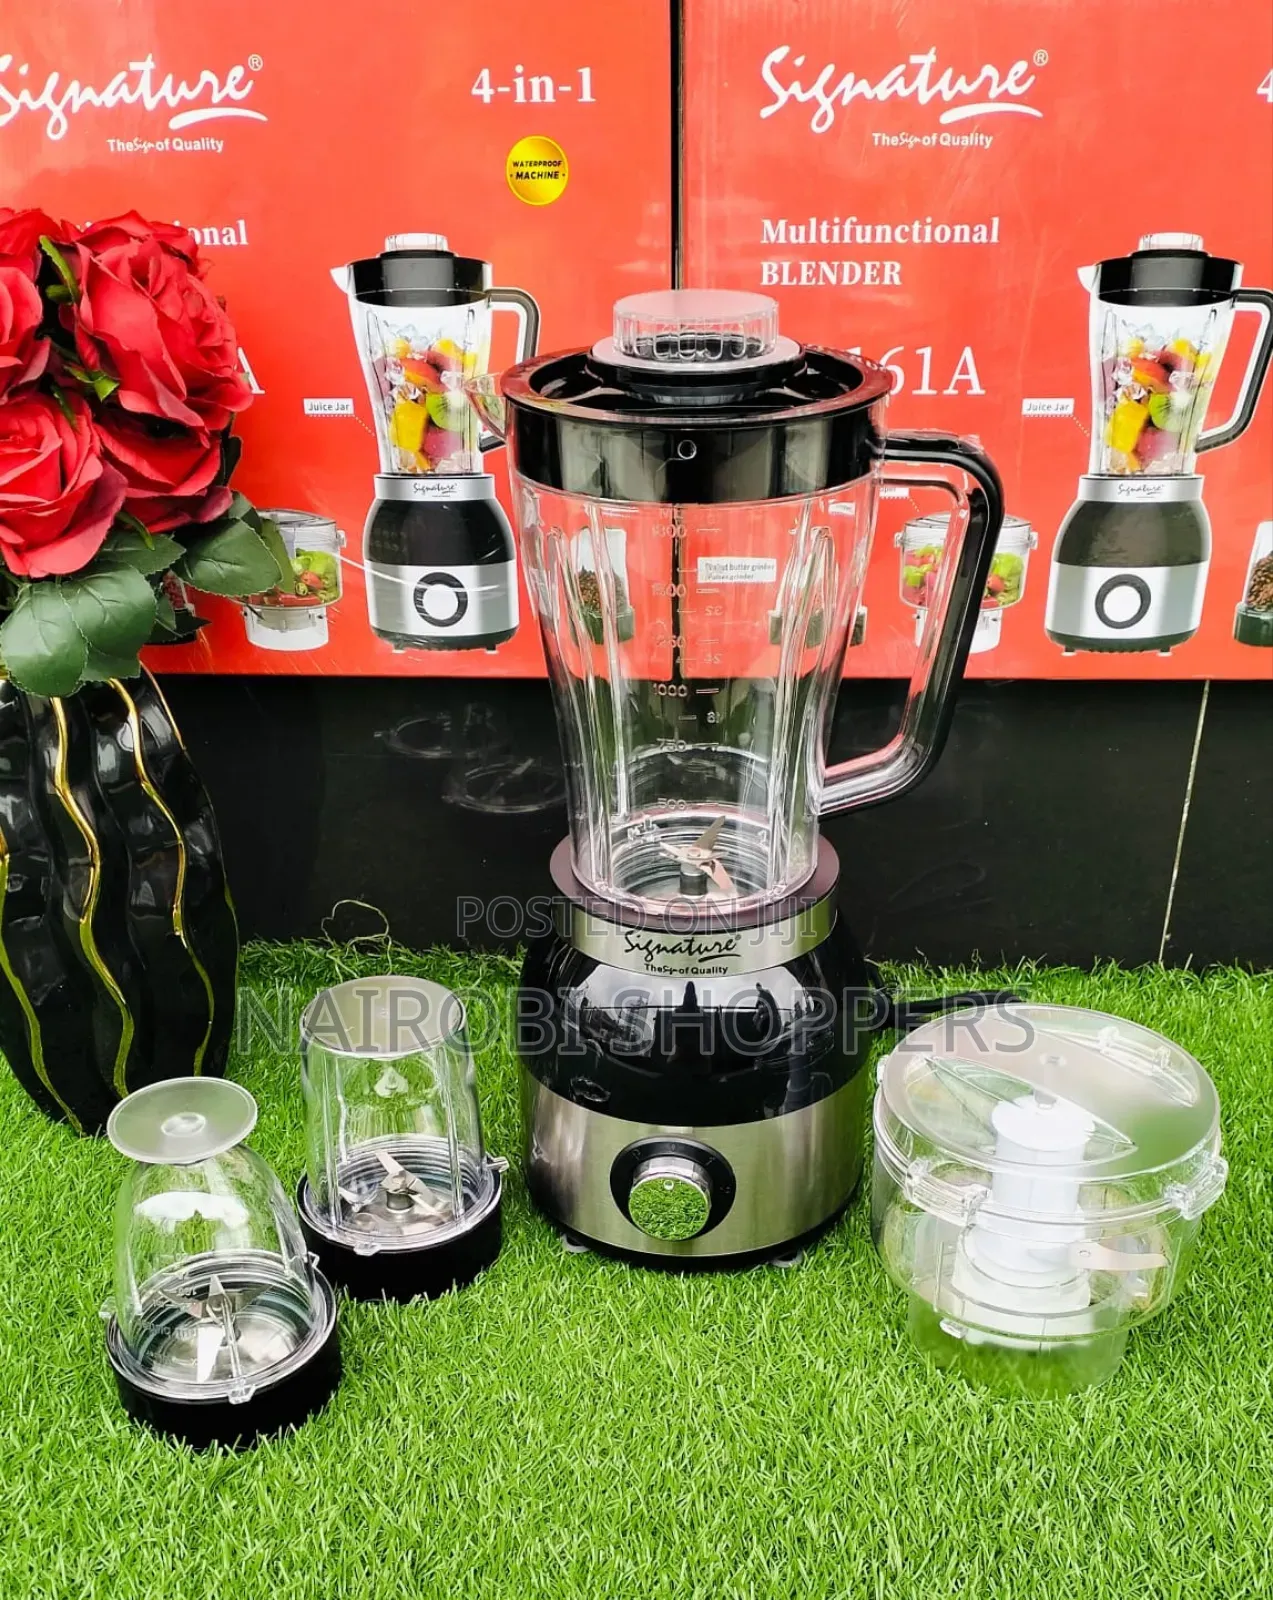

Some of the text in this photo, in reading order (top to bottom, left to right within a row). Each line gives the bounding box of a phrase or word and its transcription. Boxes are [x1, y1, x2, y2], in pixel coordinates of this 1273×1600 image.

[470, 63, 597, 104] 4-in-1
[172, 137, 224, 154] Quality
[939, 132, 993, 150] Quality
[512, 160, 562, 168] WATERPROOF
[515, 171, 560, 180] MACHINE
[760, 216, 1001, 245] Multifunctional
[760, 260, 903, 286] BLENDER
[308, 401, 350, 411] Juice Jar
[1026, 402, 1052, 411] Juice
[653, 683, 688, 697] 1000
[624, 930, 738, 963] Signature
[691, 965, 728, 975] Quality
